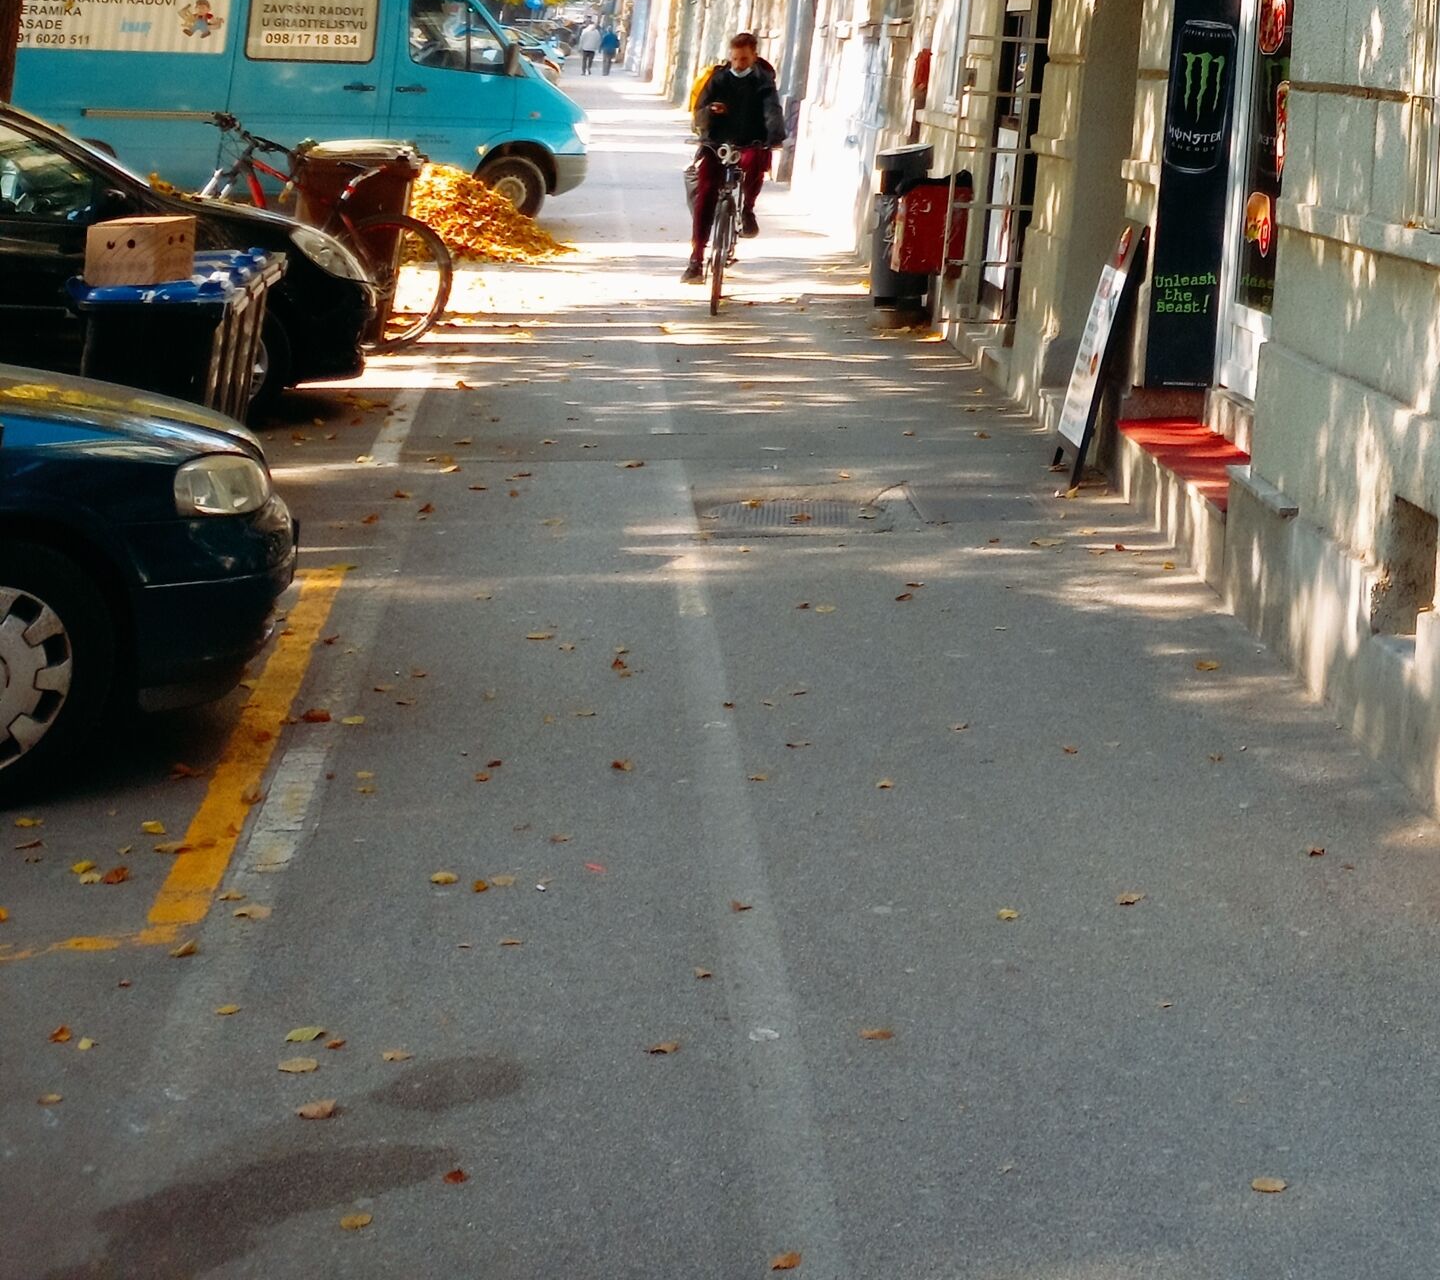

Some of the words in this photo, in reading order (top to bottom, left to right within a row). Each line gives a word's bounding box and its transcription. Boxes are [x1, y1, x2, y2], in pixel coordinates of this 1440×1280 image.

[21, 4, 82, 17] ERAMIKA
[319, 5, 364, 17] RADOVI
[18, 18, 63, 30] ASADE
[262, 18, 270, 27] U
[36, 33, 65, 44] 6020
[69, 34, 90, 46] 511
[315, 34, 329, 45] 18
[334, 34, 358, 46] 834
[1155, 272, 1217, 288] Unleash
[1165, 288, 1193, 302] the
